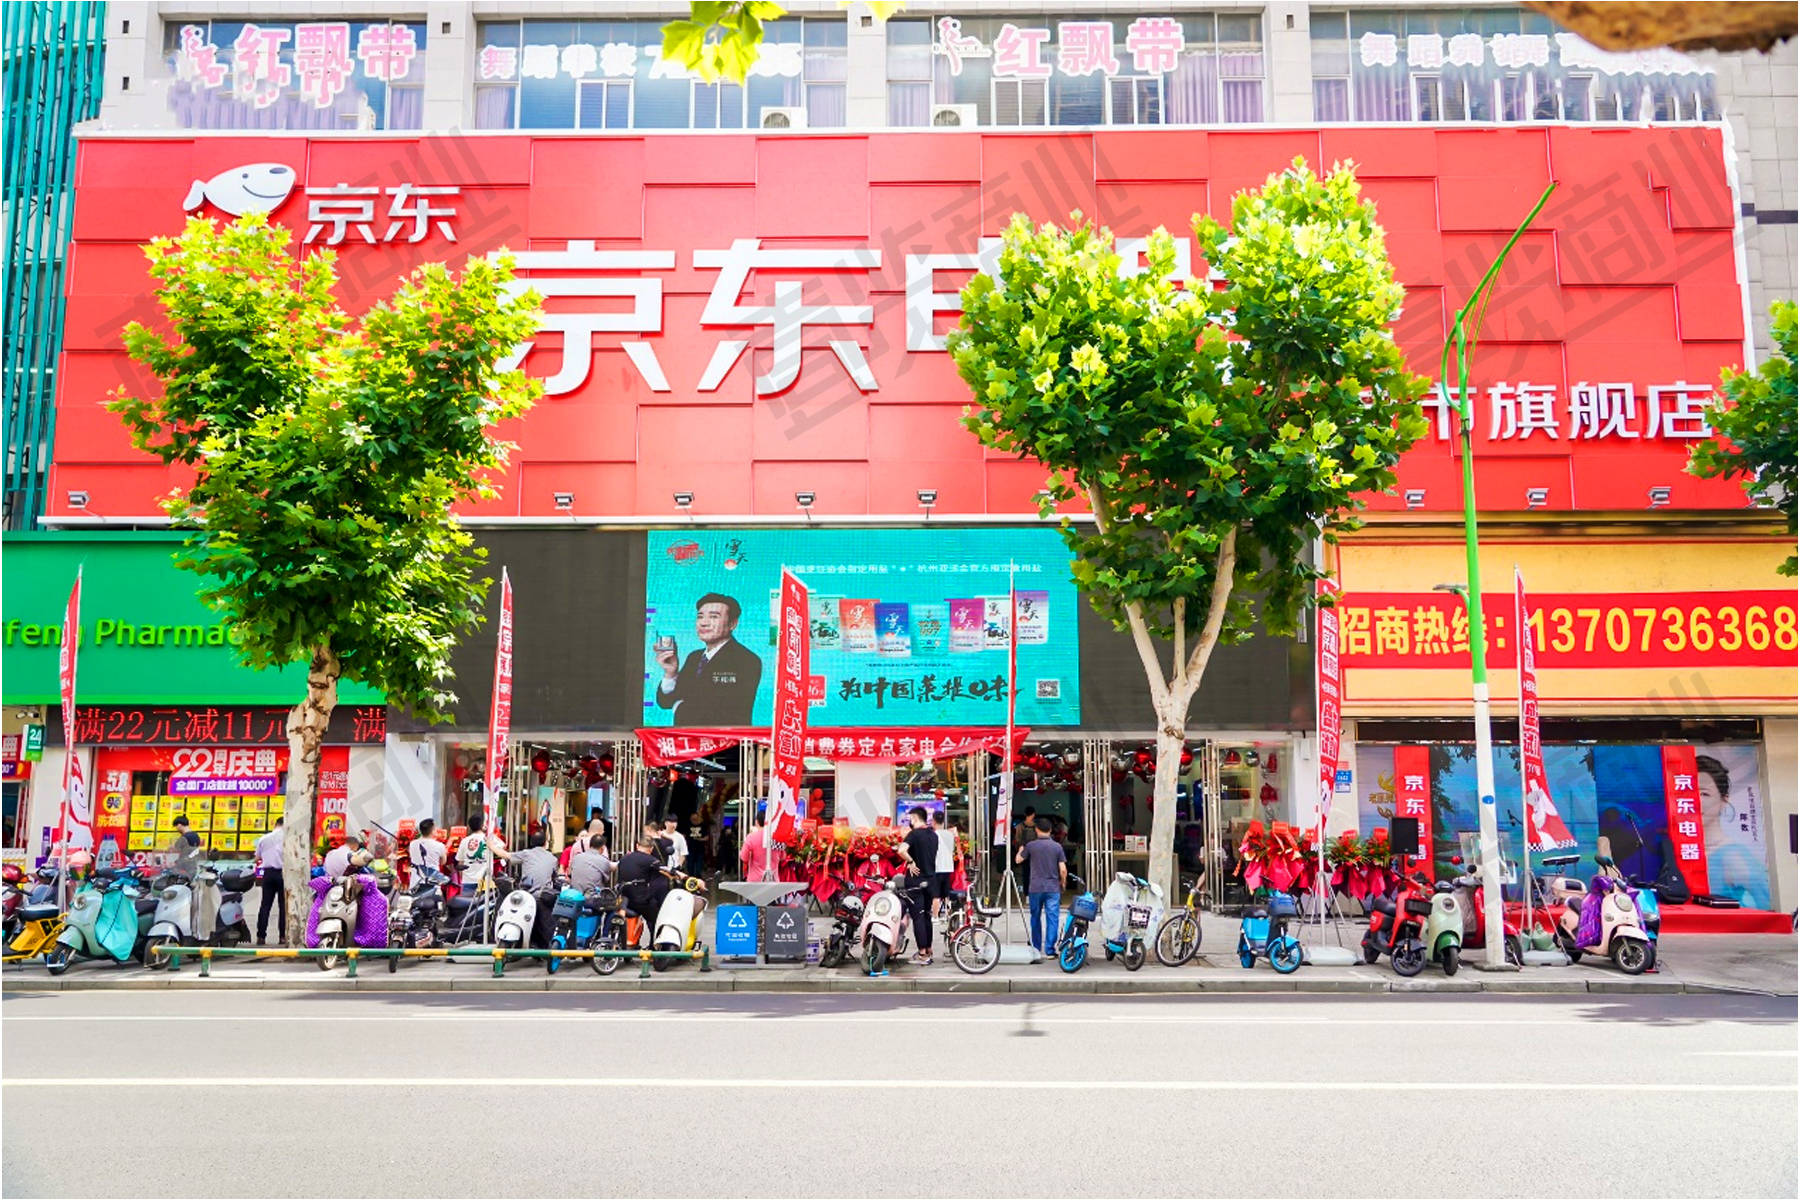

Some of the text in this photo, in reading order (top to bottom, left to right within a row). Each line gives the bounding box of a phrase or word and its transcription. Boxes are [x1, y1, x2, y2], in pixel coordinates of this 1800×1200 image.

[235, 23, 416, 107] 红飘带
[993, 17, 1186, 77] 红飘带
[304, 183, 460, 244] 京东
[487, 238, 1240, 396] 京东
[1673, 774, 1700, 860] 京东电器
